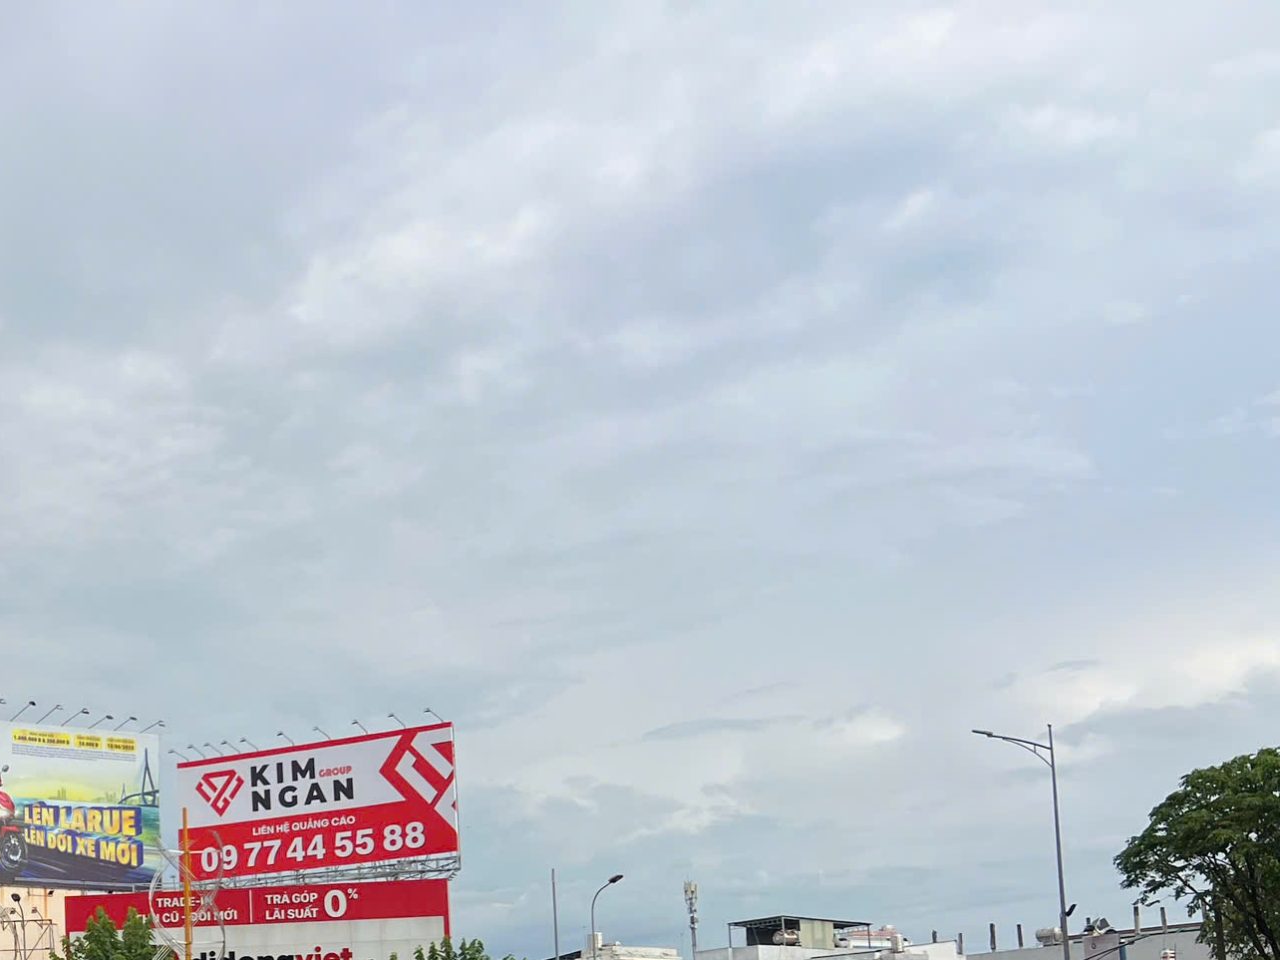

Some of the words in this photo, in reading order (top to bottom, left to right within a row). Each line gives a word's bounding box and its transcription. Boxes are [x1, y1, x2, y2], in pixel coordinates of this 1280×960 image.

[250, 758, 317, 788] KIM
[319, 765, 353, 778] GROUP
[251, 777, 355, 813] NGAN
[24, 801, 55, 827] LÊN
[60, 806, 137, 837] LARUE
[252, 825, 275, 837] LIÊN
[276, 820, 291, 834] HỆ
[291, 816, 329, 832] QUẢNG
[331, 814, 357, 827] CÁO
[24, 824, 45, 848] LÊN
[76, 837, 96, 857] XE
[100, 836, 138, 867] MỚI
[200, 844, 238, 873] 09
[243, 839, 282, 868] 77
[286, 835, 326, 863] 44
[334, 828, 375, 858] 55
[382, 821, 426, 850] 88
[265, 908, 286, 921] LÃI
[287, 906, 319, 919] SUẤT
[292, 890, 318, 904] GÓP
